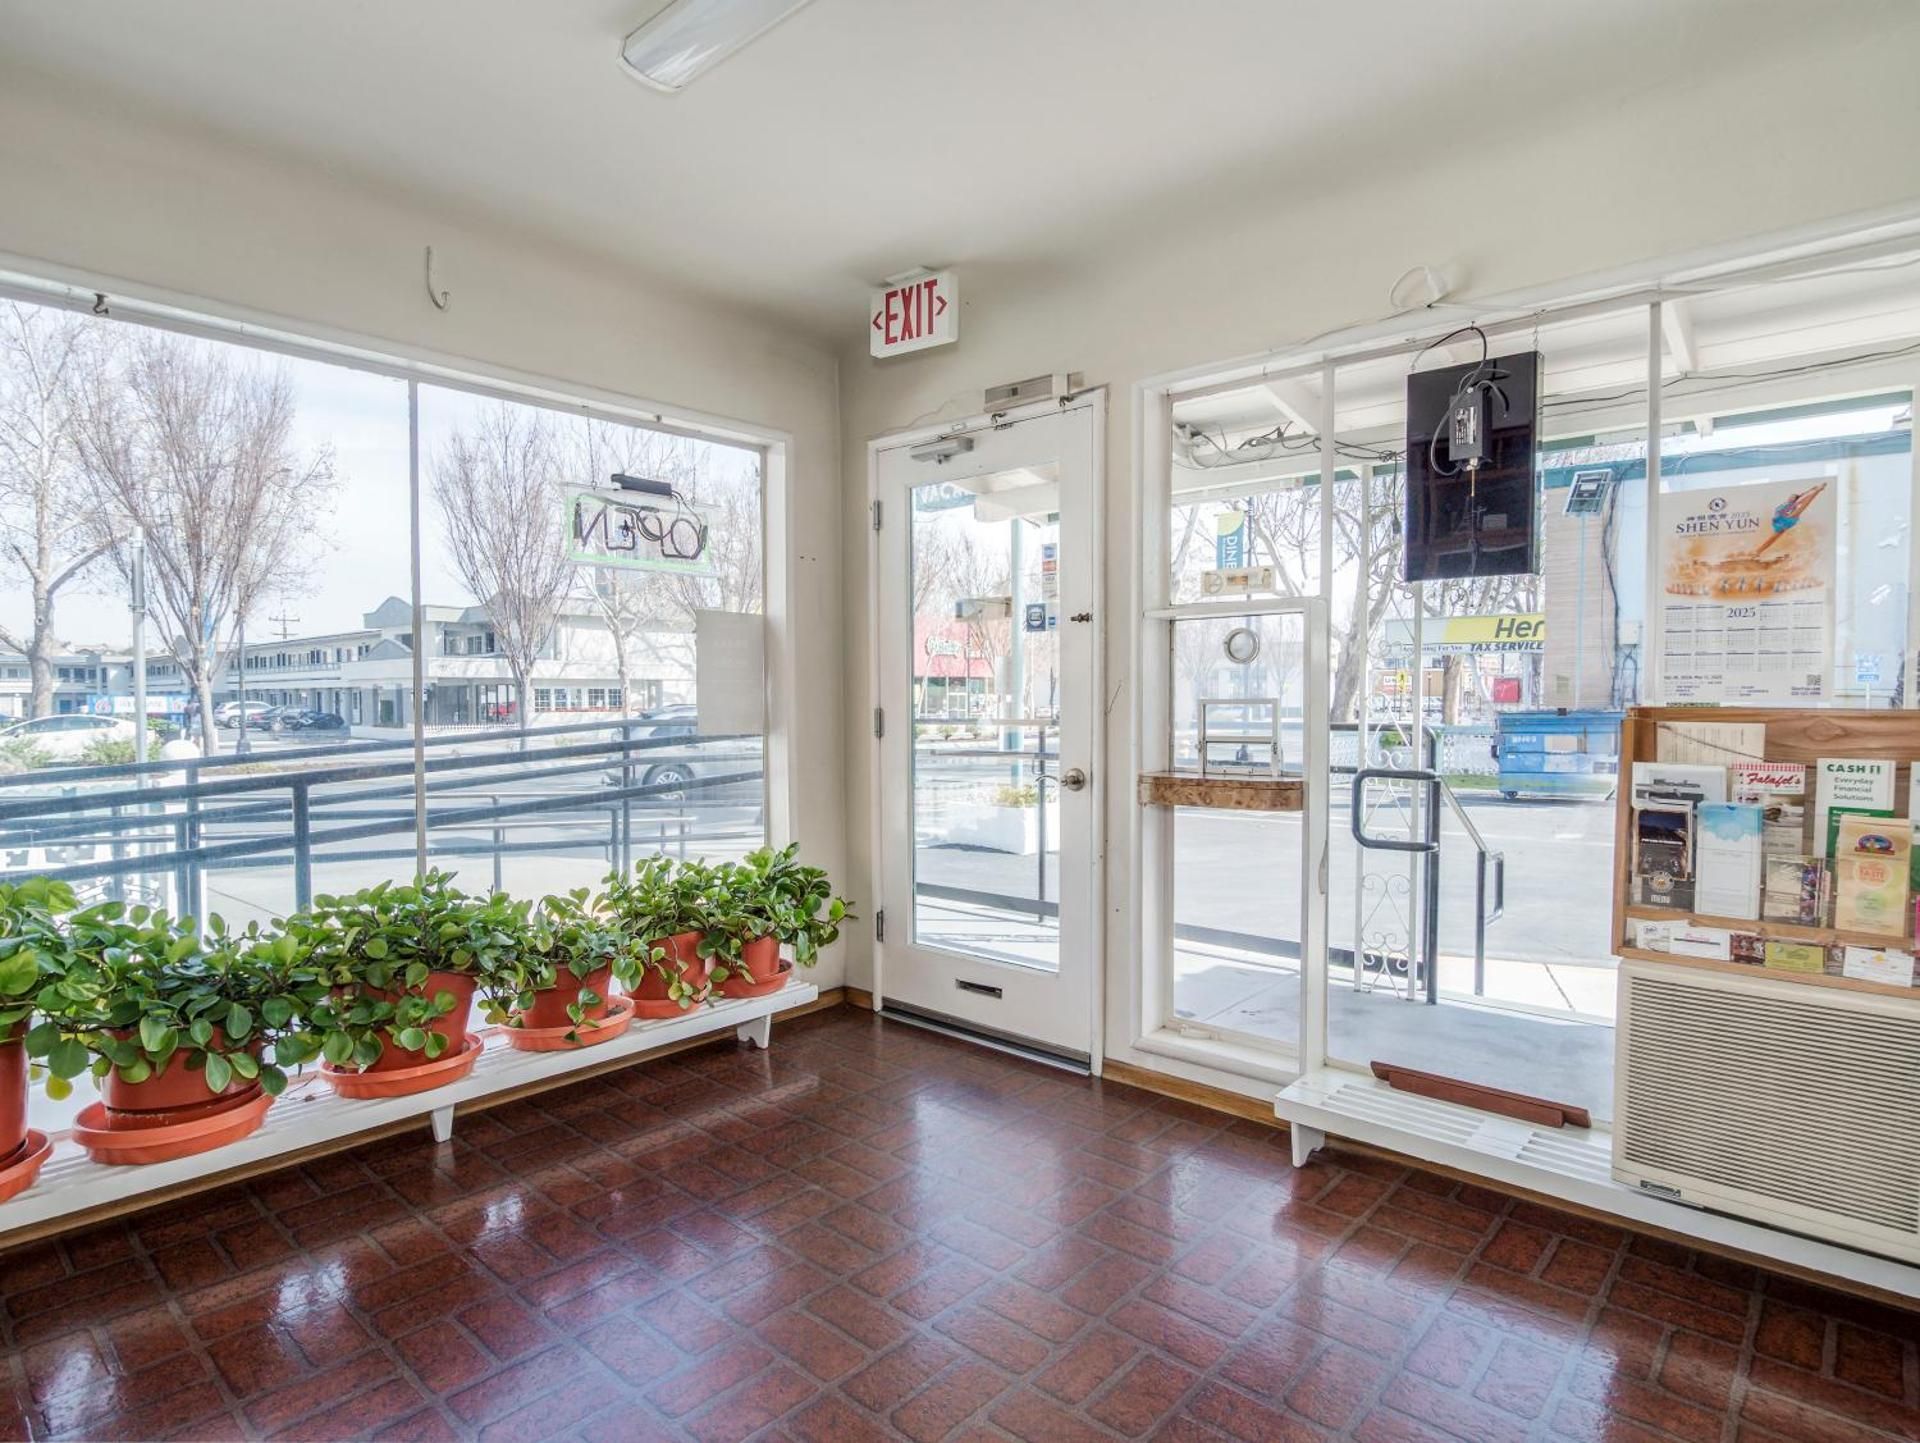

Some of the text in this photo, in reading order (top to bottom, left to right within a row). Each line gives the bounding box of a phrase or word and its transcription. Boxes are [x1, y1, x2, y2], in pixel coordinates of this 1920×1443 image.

[886, 279, 938, 345] EXIT
[1675, 521, 1720, 534] SHEN
[1725, 518, 1760, 530] YUN
[1727, 607, 1756, 618] 2025
[1470, 642, 1492, 652] TAX
[1827, 764, 1866, 774] CASH
[1746, 772, 1801, 788] Falafel's
[1834, 777, 1874, 786] Everyday
[1834, 785, 1872, 793] Financial
[1833, 793, 1874, 801] Solutions
